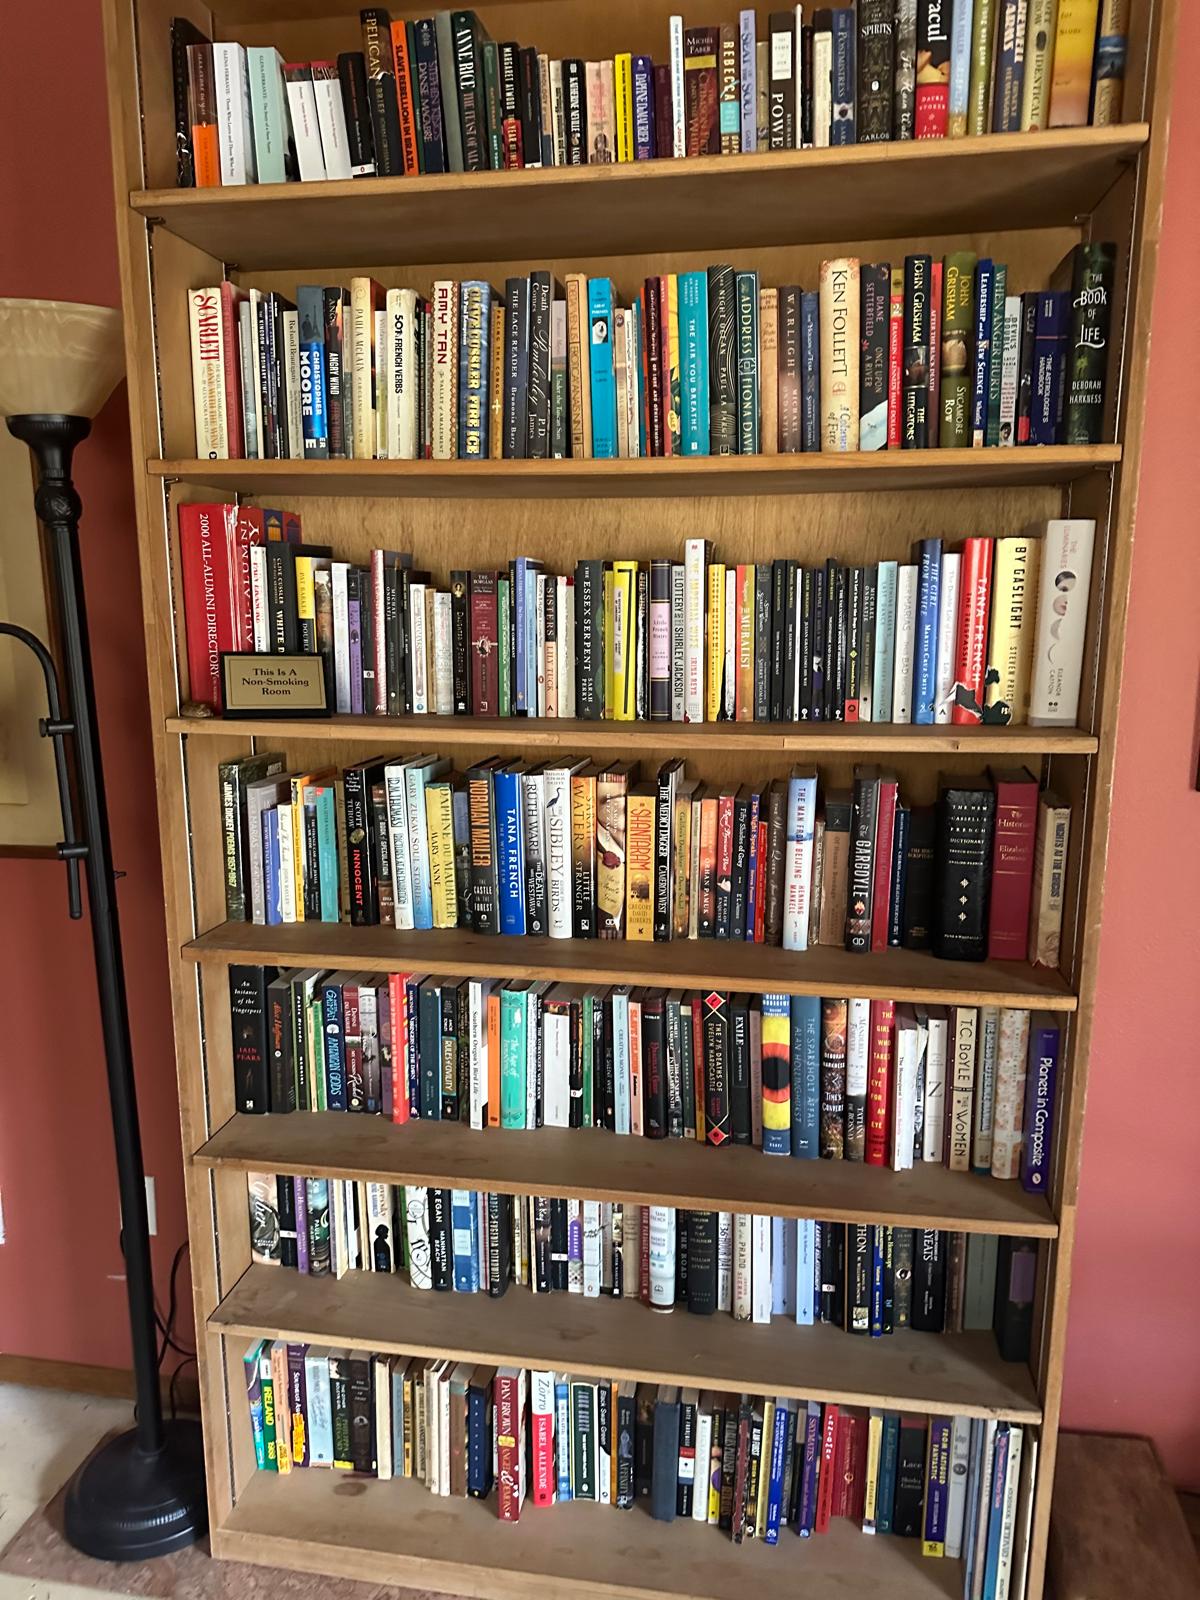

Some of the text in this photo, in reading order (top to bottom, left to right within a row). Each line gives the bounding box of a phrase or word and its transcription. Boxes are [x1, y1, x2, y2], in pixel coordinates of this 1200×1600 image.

[366, 17, 382, 79] PELICAN
[861, 24, 892, 35] SPIRITS
[456, 28, 476, 89] ANNE RICE
[503, 47, 515, 110] MARGARET ATWOOD
[724, 41, 736, 101] REBECCA
[741, 32, 752, 119] SEAT SOUL
[838, 31, 847, 98] POSTMISTRESS
[395, 44, 414, 172] SLAVE REBELLION IN BRAZIL
[635, 73, 648, 103] DAPHNE
[1030, 54, 1043, 120] IDENTICAL
[420, 98, 433, 143] MACABRE
[570, 110, 580, 132] NEVILLE
[531, 282, 539, 312] Comes
[541, 284, 549, 311] Death
[865, 282, 875, 337] SETTERFIELD
[875, 295, 884, 322] DIANE
[912, 259, 925, 343] JOHN GRISHAM
[946, 267, 958, 321] GRISHAM
[960, 274, 970, 306] JOHN
[1073, 288, 1106, 308] BOOK
[193, 295, 220, 362] SCARLETT
[355, 308, 364, 337] PAULA
[438, 288, 448, 364] AMY TAN
[787, 293, 795, 379] WARLIGHT
[832, 270, 848, 376] KEN FOLLETT
[976, 273, 990, 395] LEADERSHIP SCIENCE
[990, 270, 1006, 400] WHEN ANGER HURTS
[1075, 325, 1106, 349] LIFE
[329, 352, 340, 395] ANGRY WIND
[395, 369, 403, 394] VERBS
[528, 326, 549, 406] Pemberley
[741, 295, 753, 417] ADDRESS FIONA
[864, 362, 873, 387] RIVER
[1037, 356, 1046, 396] HANDBOOK
[300, 351, 312, 416] MOORE
[313, 351, 322, 416] CHRISTOPHER
[466, 329, 480, 454] CUSSLER FIRE ICE
[955, 386, 966, 434] SYCAMORE
[1071, 381, 1102, 390] DEBORAH
[906, 392, 916, 440] LITIGATORS
[922, 553, 930, 577] FROM
[199, 513, 219, 678] 2000 ALL-ALUMNI DIRECTORY
[546, 587, 554, 636] SISTERS
[275, 610, 284, 638] WHITE
[583, 581, 591, 672] ESSEX SERPENT
[674, 578, 683, 698] LOTTERY SHIRLEY JACKSON
[741, 615, 751, 669] MURALIST
[972, 576, 987, 682] TANA FRENCH
[1006, 546, 1027, 702] BY GASLIGHT STEVEN PRICE
[242, 678, 309, 687] Non-Smoking
[252, 668, 297, 676] This Is A
[546, 668, 554, 692] TUCK
[223, 782, 235, 855] JAMES DICKEY POEMS
[469, 780, 491, 867] NORMAN MAILER
[526, 784, 538, 855] RUTH WARE
[574, 784, 584, 850] WATERS
[630, 808, 651, 871] SHANTARAM
[794, 806, 804, 879] MAN BEIJING
[439, 788, 456, 919] DAPHNE MAURIER
[506, 809, 518, 898] TANA FRENCH
[550, 818, 564, 877] SIBLEY
[658, 830, 669, 914] DAGGER CAMERON WEST
[852, 840, 870, 897] GARGOYLE
[353, 849, 363, 905] INNOCENT
[535, 872, 543, 901] DEATH
[551, 879, 560, 912] BIRDS
[326, 990, 341, 1095] GAIMAN AMERICAN GODS
[735, 1016, 743, 1045] EXILE
[807, 1017, 815, 1034] THE
[708, 1050, 716, 1092] HARDCASTLE
[716, 1081, 722, 1092] OF
[807, 1038, 815, 1092] SPARSHOLT
[1030, 1057, 1053, 1166] Planets in Composite
[434, 1198, 443, 1223] EGAN
[680, 1231, 688, 1278] THE ROAD
[738, 1241, 746, 1269] PRADO
[923, 1233, 934, 1261] YEATS
[264, 1386, 274, 1425] IRELAND
[502, 1380, 513, 1434] DAN BROWN
[538, 1379, 549, 1489] Zorro ISABEL ALLENDE
[807, 1418, 816, 1462] SKYMATES
[931, 1444, 939, 1479] FANTASTIC
[939, 1452, 948, 1485] FATIGUED
